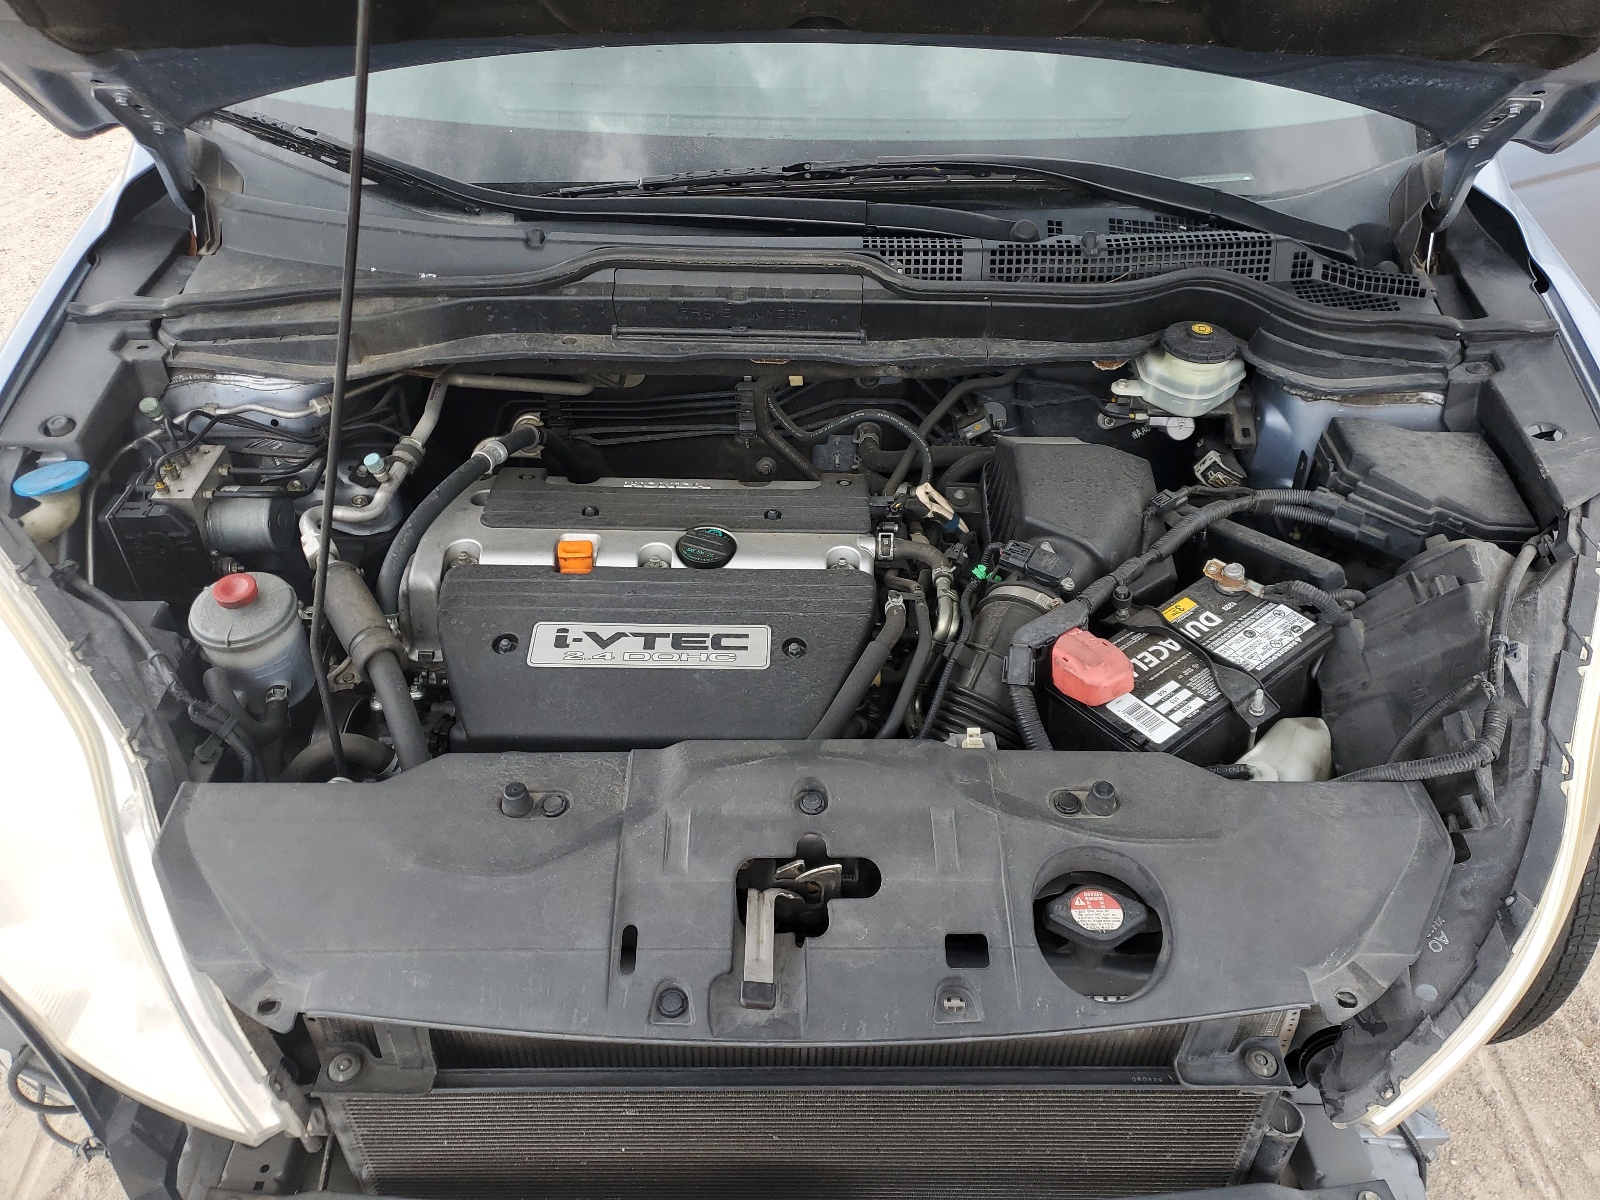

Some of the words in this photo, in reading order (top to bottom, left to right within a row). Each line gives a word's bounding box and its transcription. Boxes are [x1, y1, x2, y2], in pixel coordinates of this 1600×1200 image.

[1174, 604, 1185, 612] 3
[554, 627, 750, 651] i-VTEC
[562, 650, 615, 661] 2.4
[622, 651, 737, 663] DOHC
